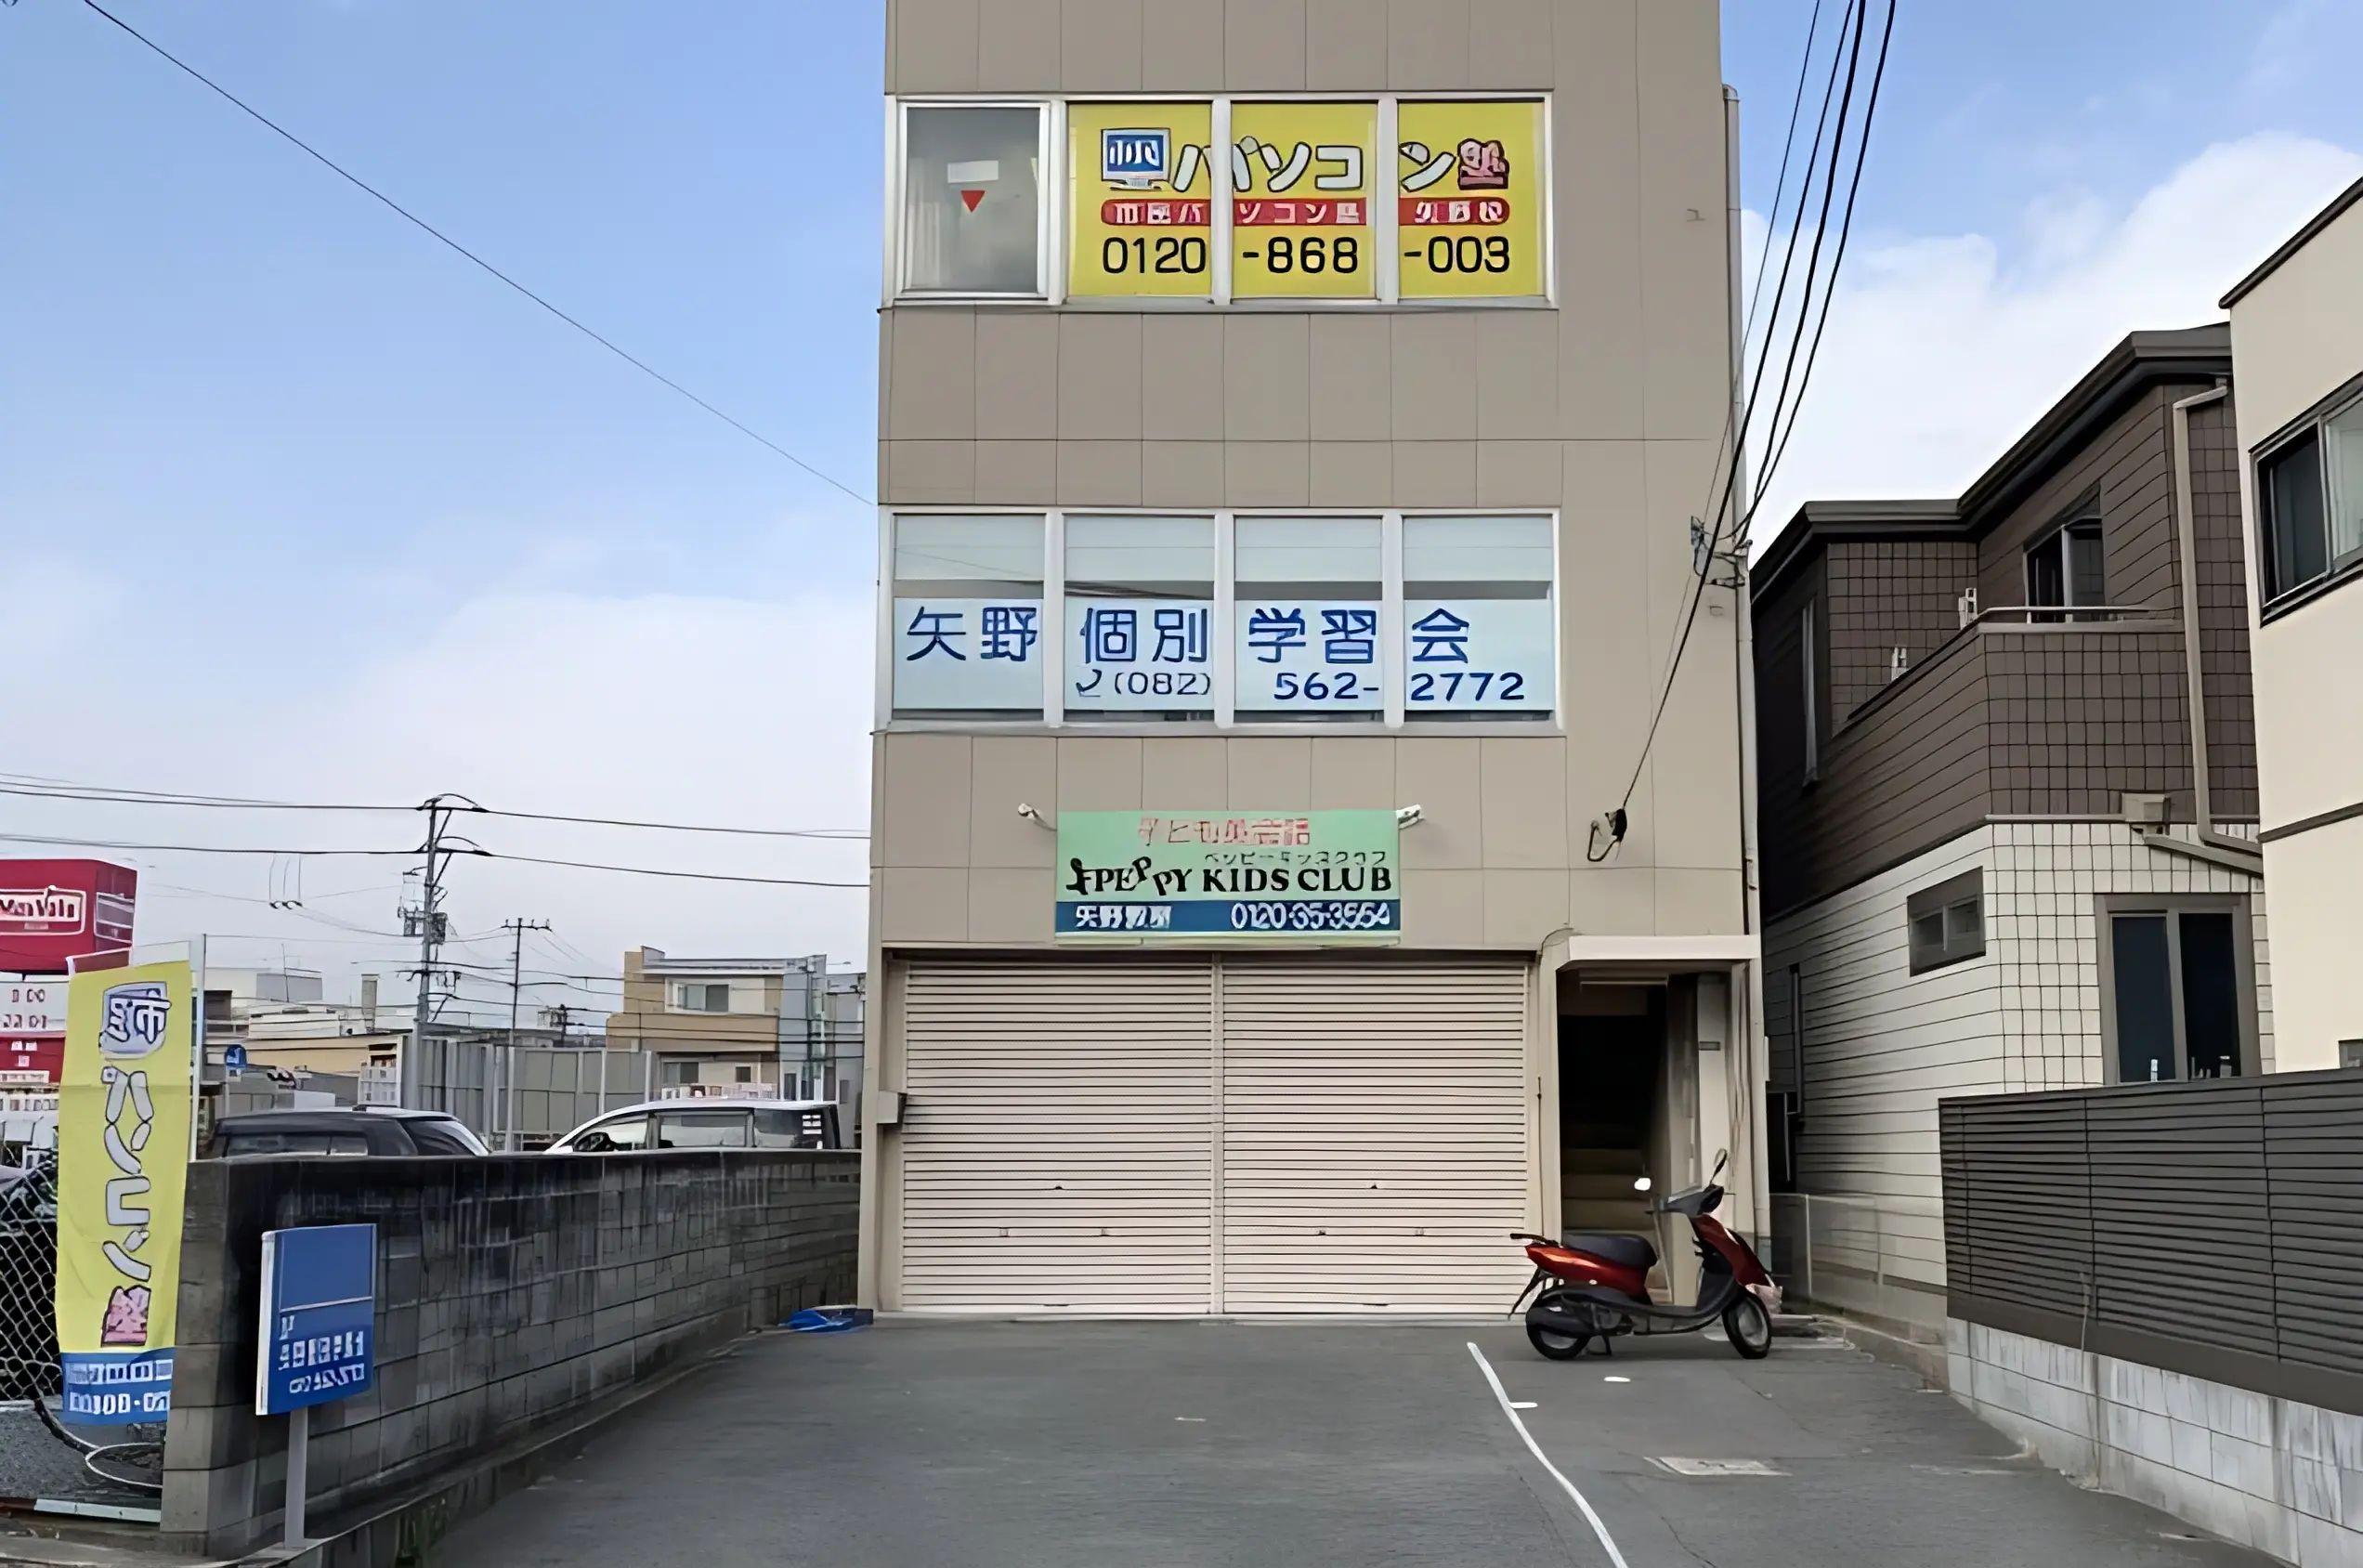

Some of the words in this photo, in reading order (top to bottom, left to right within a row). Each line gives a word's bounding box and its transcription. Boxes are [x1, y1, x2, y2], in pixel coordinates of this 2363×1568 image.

[907, 605, 1470, 664] 矢野個別学習会
[1203, 868, 1289, 893] KIDS
[1298, 866, 1392, 893] CLUB
